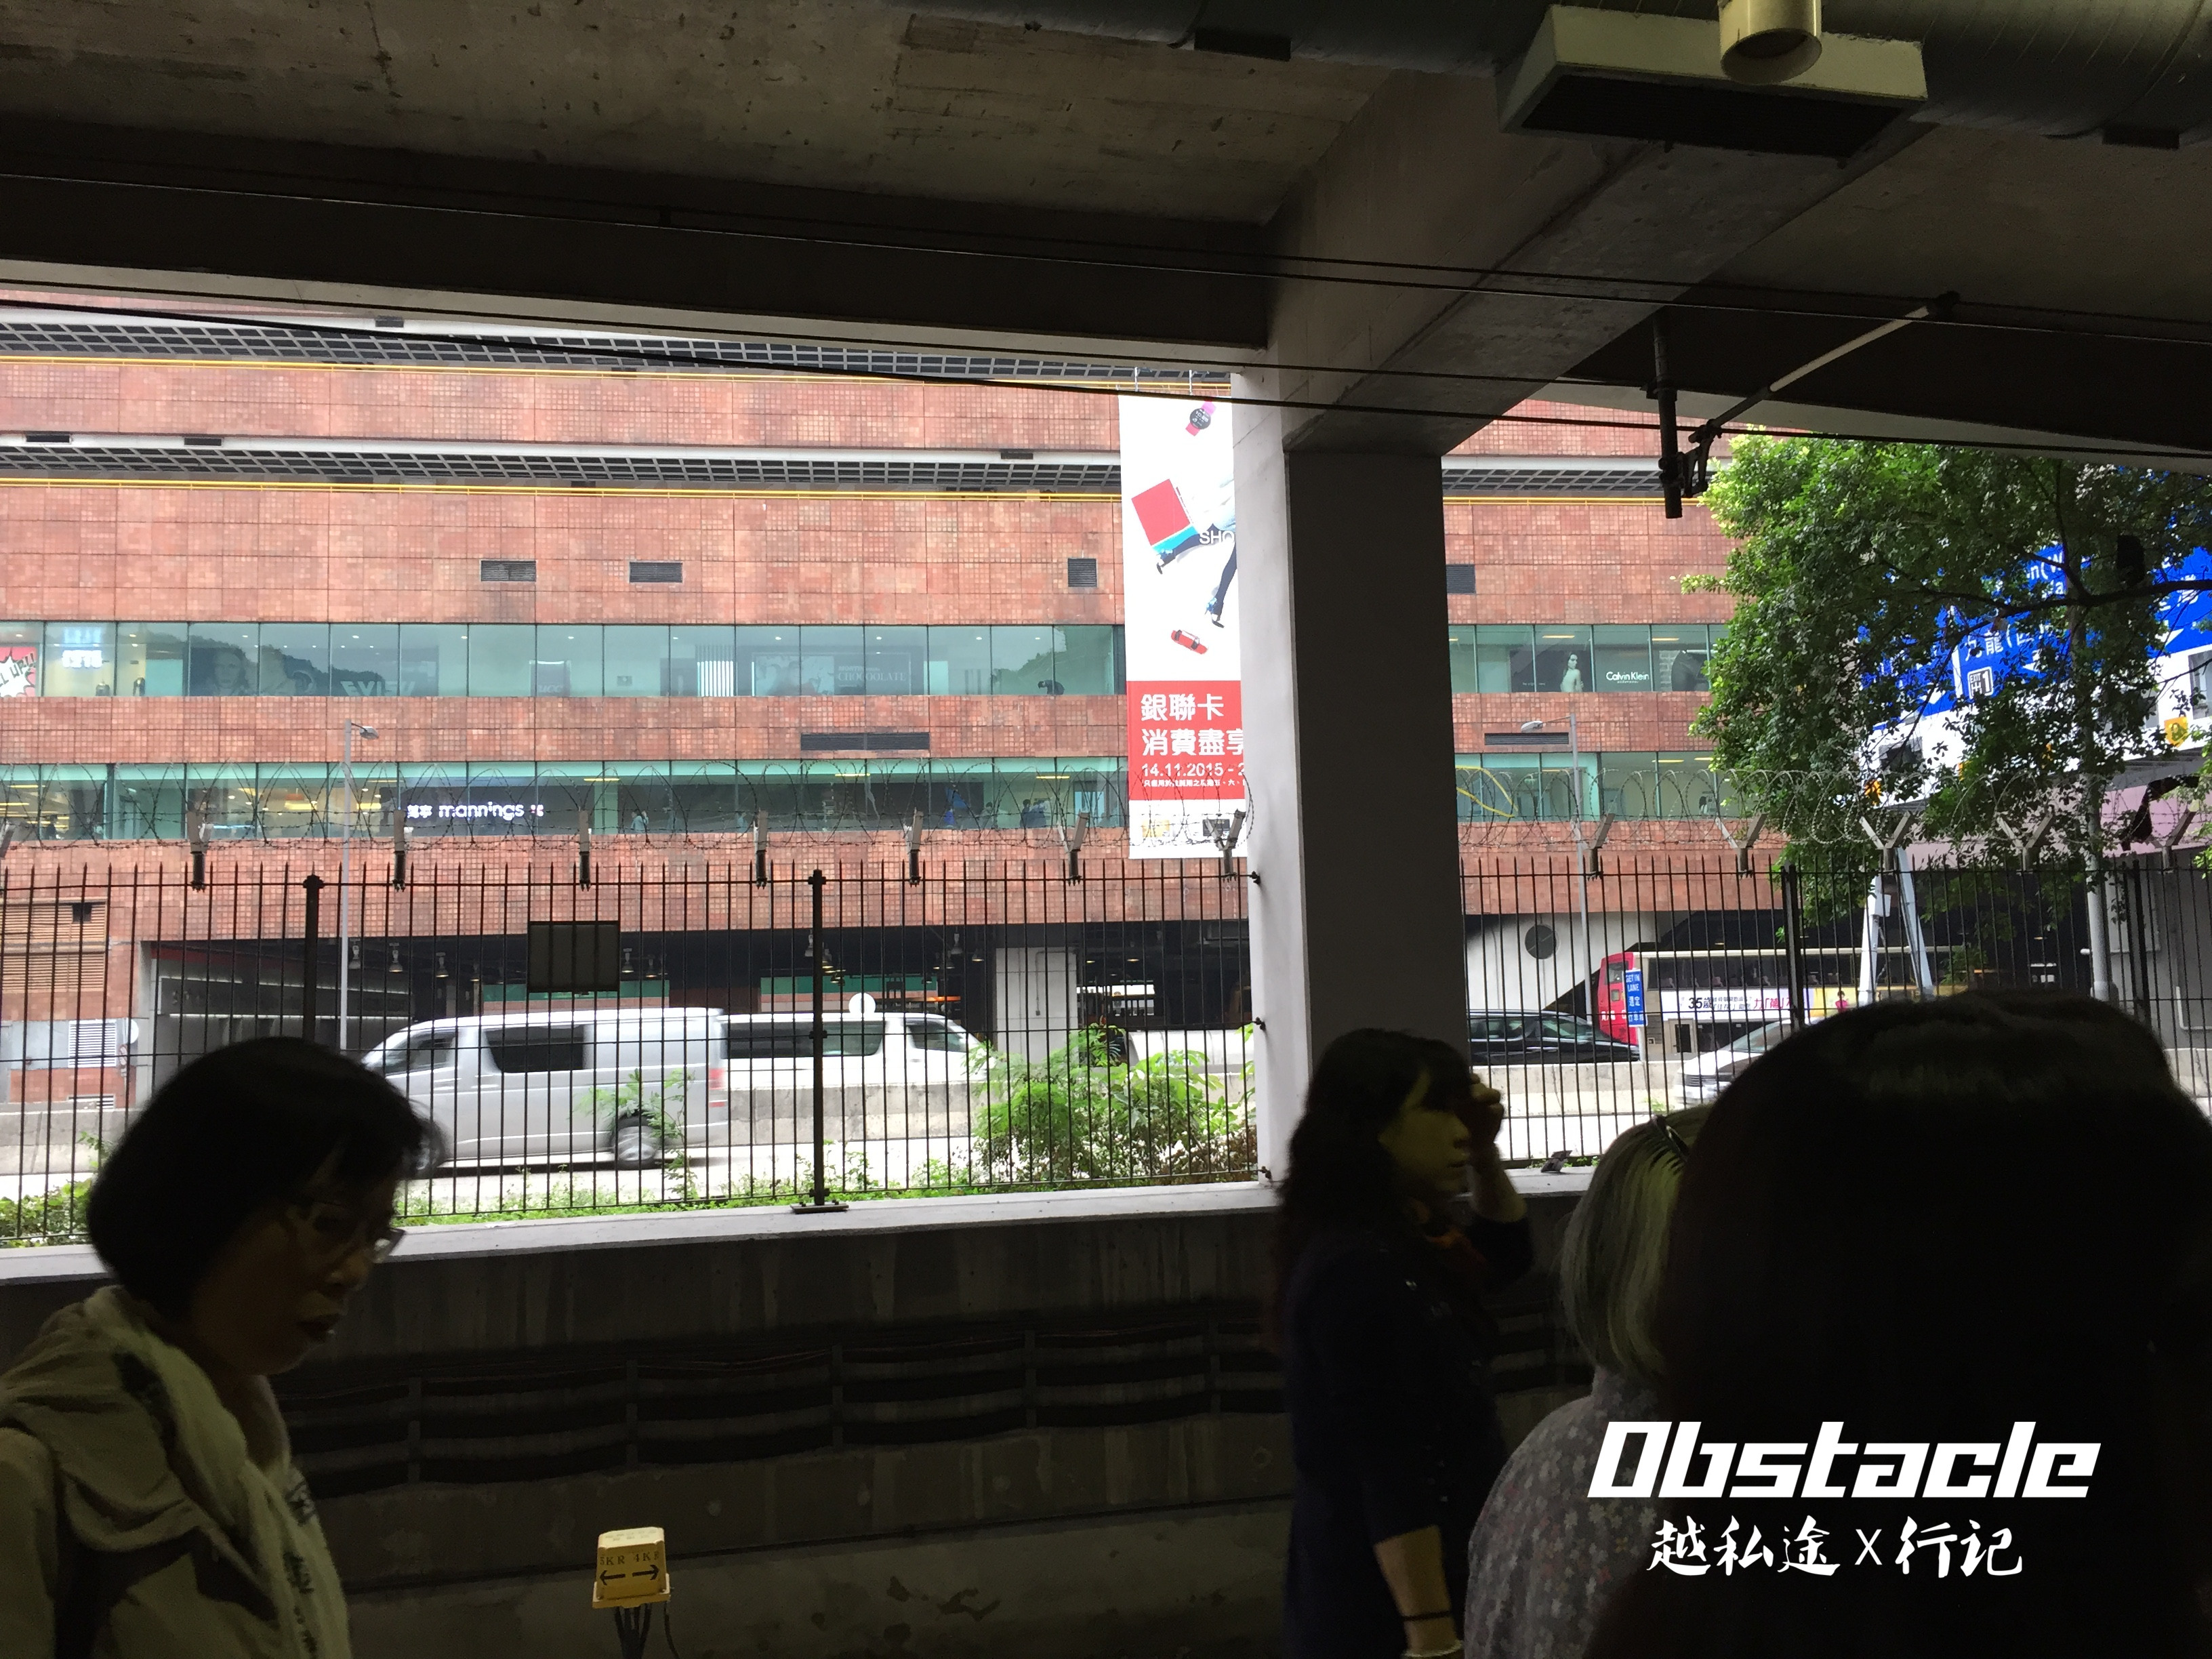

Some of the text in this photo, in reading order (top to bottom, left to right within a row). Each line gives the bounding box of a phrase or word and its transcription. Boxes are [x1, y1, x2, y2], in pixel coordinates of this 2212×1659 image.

[1606, 672, 1650, 680] Calvin Klein
[1141, 693, 1224, 722] 銀聯卡
[1141, 762, 1224, 777] 14.11.2015
[438, 801, 525, 821] mannings
